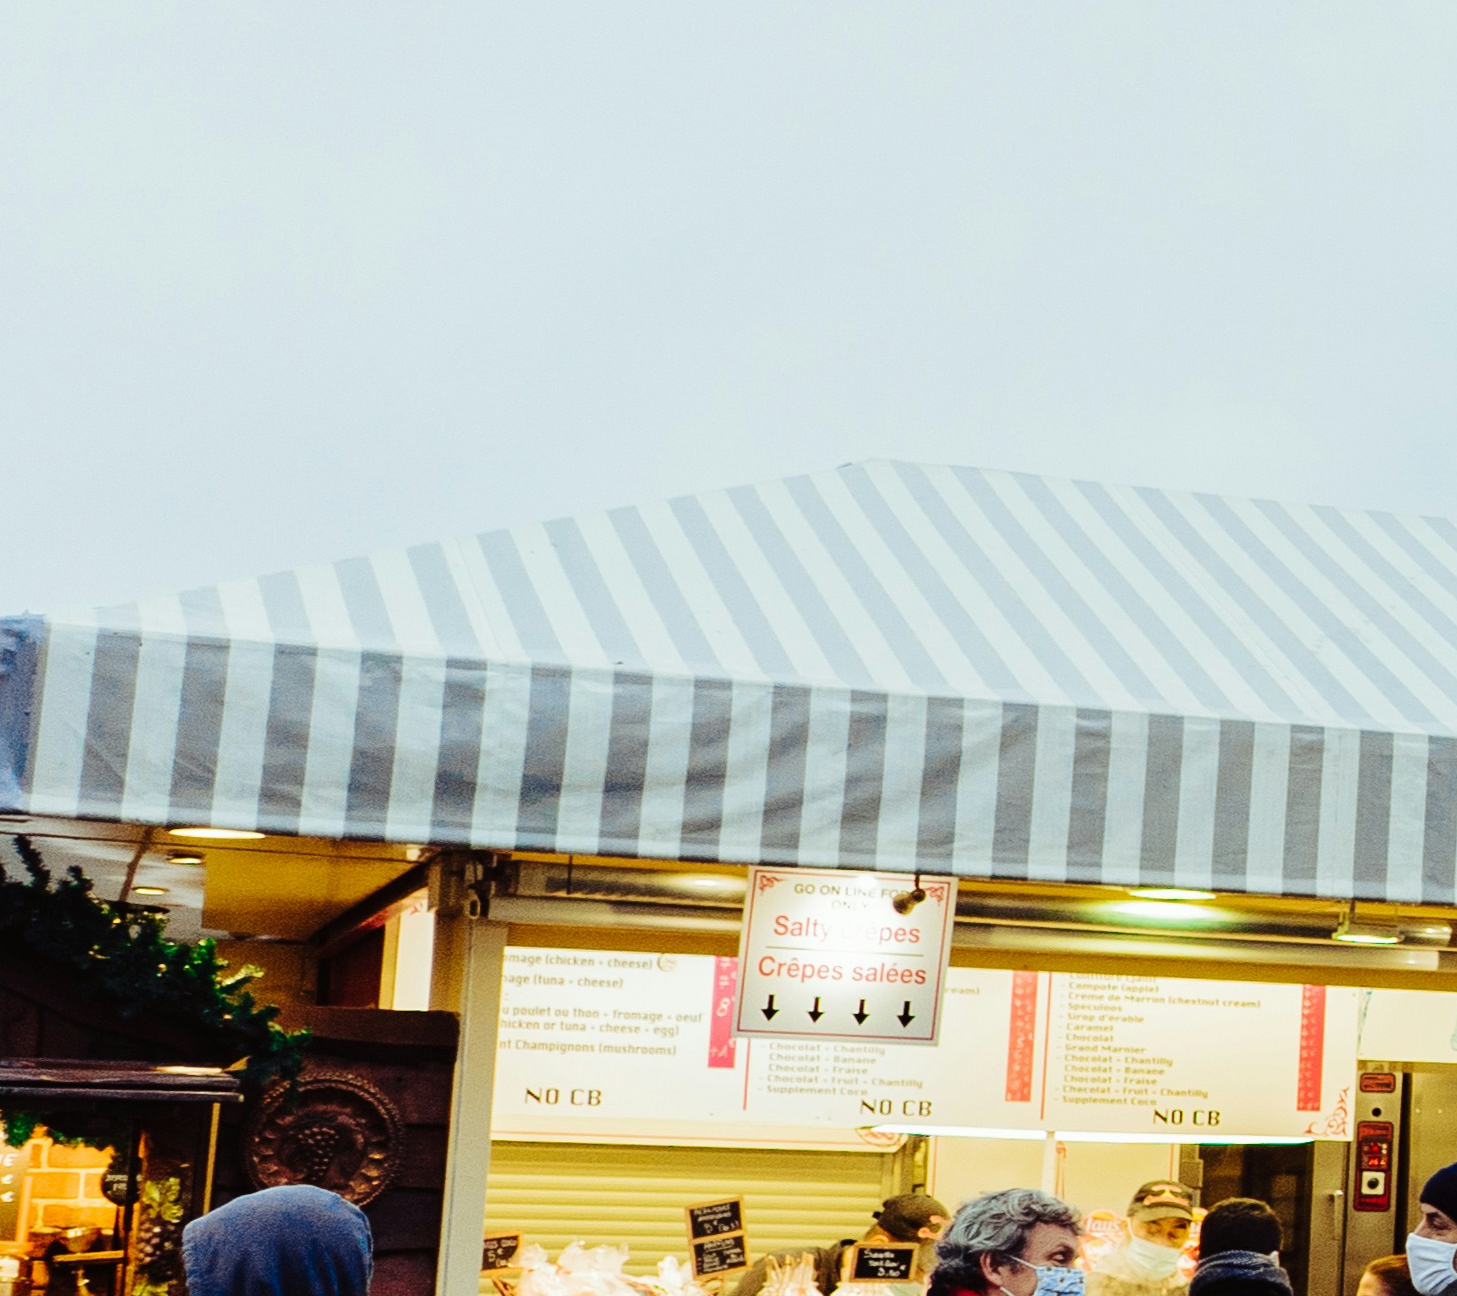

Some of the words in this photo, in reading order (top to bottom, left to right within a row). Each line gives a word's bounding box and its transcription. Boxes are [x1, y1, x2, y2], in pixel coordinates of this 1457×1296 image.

[794, 883, 814, 895] GO
[820, 885, 841, 895] ON
[845, 887, 876, 898] LINE
[773, 915, 831, 943] Salty
[608, 958, 652, 970] cheese)
[758, 955, 843, 984] Crêpes
[852, 962, 927, 985] salées
[534, 975, 564, 986] (tuna
[577, 978, 624, 990] cheese)
[1069, 982, 1118, 992] Compote
[1121, 984, 1159, 993] (apple)
[945, 987, 980, 996] ream)
[1068, 1003, 1122, 1012] Speculoos
[1108, 993, 1121, 1001] de
[1124, 995, 1165, 1004] Marron
[1168, 996, 1219, 1006] (chestnut
[1222, 1000, 1261, 1009] cream)
[513, 1007, 551, 1019] poulet
[555, 1009, 568, 1018] ou
[574, 1007, 599, 1019] thon
[613, 1010, 663, 1023] fromage
[676, 1013, 703, 1023] oeuf
[1067, 1013, 1095, 1022] Sirop
[544, 1022, 556, 1031] or
[560, 1022, 587, 1032] tuna
[600, 1023, 640, 1035] cheese
[653, 1025, 679, 1038] egg)
[1066, 1023, 1113, 1032] Caramel
[1066, 1033, 1113, 1042] Chocolat
[515, 1039, 595, 1055] Champignons
[599, 1043, 676, 1057] (mushrooms)
[769, 1042, 821, 1052] Chocolat
[833, 1045, 885, 1055] Chantilly
[1065, 1044, 1098, 1053] Grand
[1101, 1045, 1146, 1054] Marnier
[769, 1053, 820, 1063] Chocolat
[833, 1056, 876, 1065] Banane
[1064, 1054, 1112, 1063] Chocolat
[1124, 1057, 1174, 1067] Chantilly
[768, 1063, 820, 1072] Chocolat
[832, 1066, 868, 1075] Fraise
[1064, 1064, 1112, 1073] Chocolat
[1124, 1066, 1165, 1075] Banane
[767, 1074, 819, 1084] Chocolat
[832, 1077, 859, 1085] Fruit
[872, 1078, 923, 1089] Chantilly
[1064, 1074, 1112, 1084] Chocolat
[1124, 1077, 1158, 1085] Fraise
[525, 1088, 559, 1106] NO
[570, 1088, 602, 1107] CB
[840, 1088, 868, 1096] Coco
[1063, 1085, 1111, 1094] Chocolat
[1123, 1087, 1148, 1095] Fruit
[1160, 1089, 1209, 1099] Chantilly
[860, 1099, 893, 1115] NO
[903, 1100, 932, 1117] CB
[1131, 1098, 1157, 1106] Coco
[1153, 1109, 1183, 1125] NO
[1193, 1109, 1221, 1126] CB
